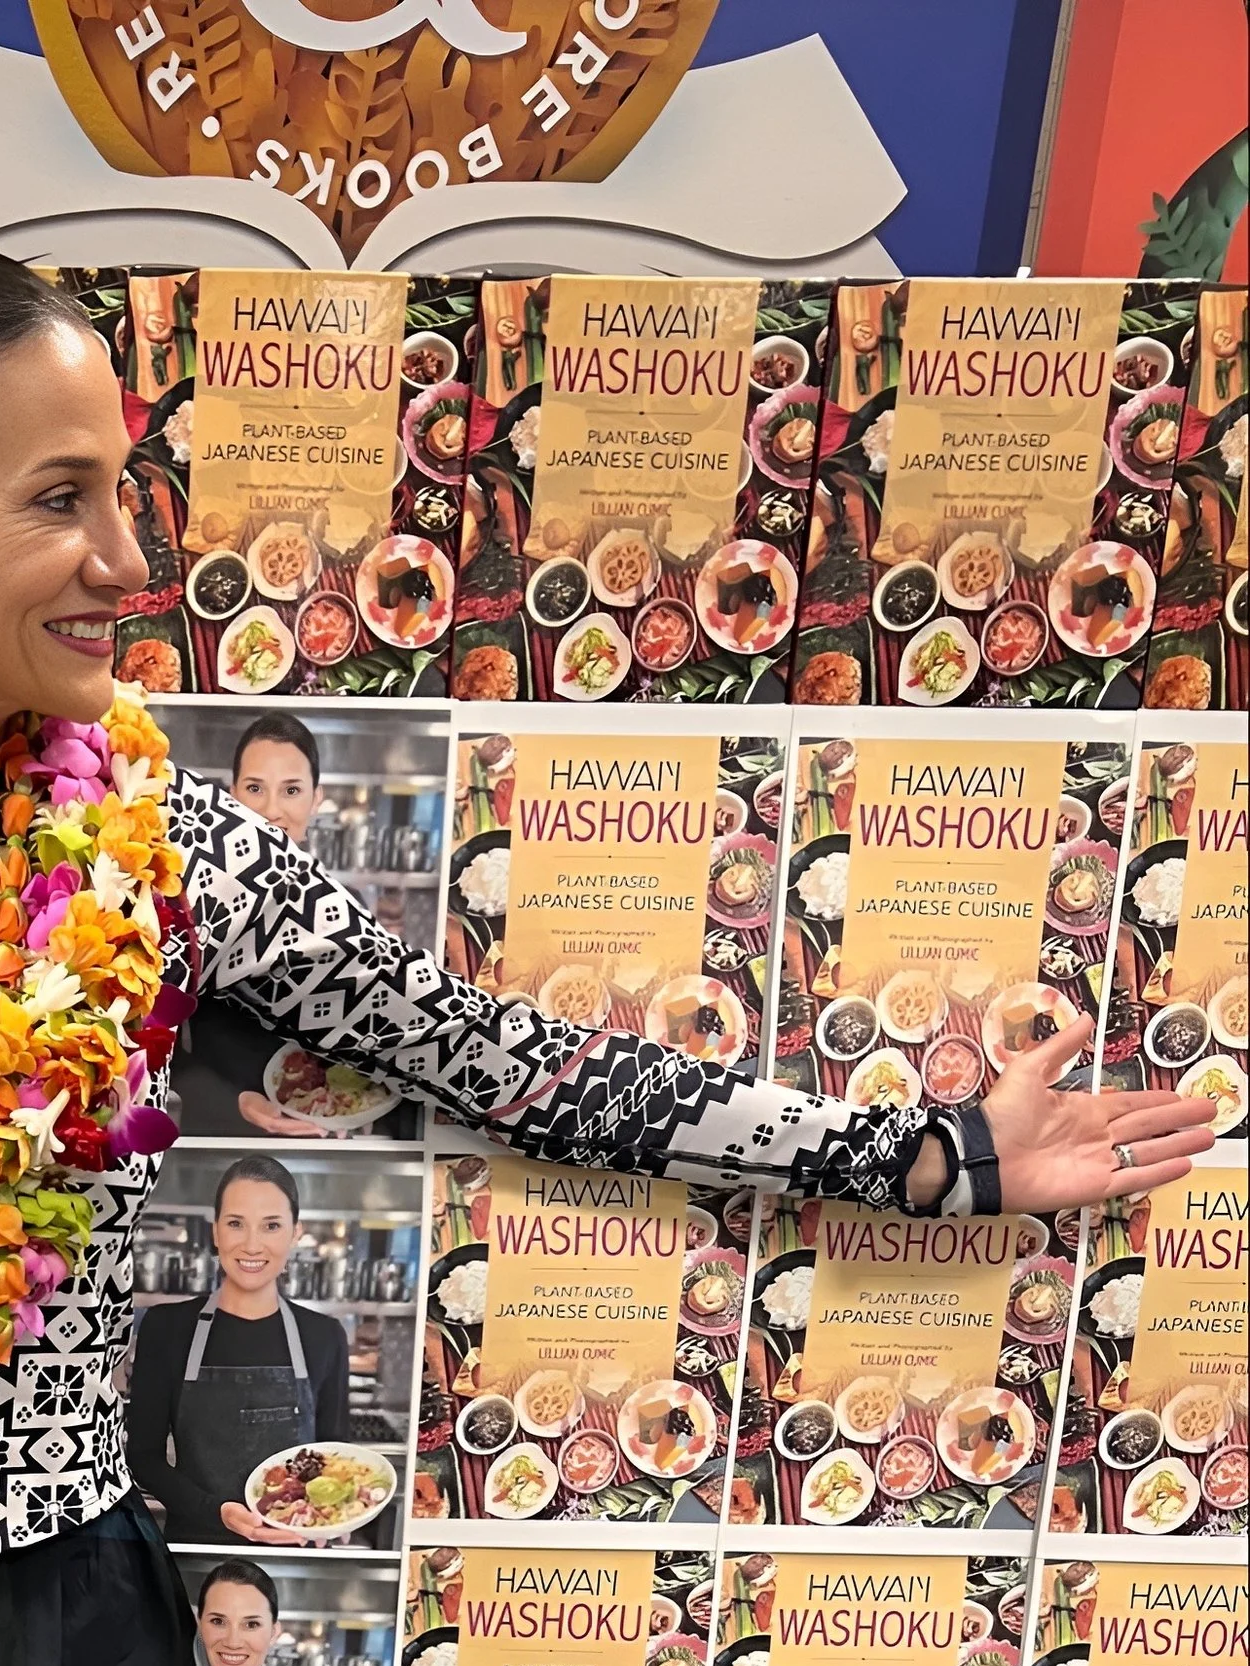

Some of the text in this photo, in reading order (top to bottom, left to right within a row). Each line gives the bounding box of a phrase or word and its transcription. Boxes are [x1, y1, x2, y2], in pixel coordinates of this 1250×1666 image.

[250, 124, 504, 209] BOOKS
[202, 340, 394, 392] WASHOKU
[552, 346, 742, 396] WASHOKU
[908, 350, 1106, 398] WASHOKU
[202, 444, 384, 464] JAPANESE CUISINE
[546, 450, 728, 470] JAPANESE CUISINE
[900, 454, 1088, 472] JAPANESE CUISINE
[520, 800, 706, 844] WASHOKU
[860, 804, 1048, 850] WASHOKU
[518, 894, 694, 912] JAPANESE CUISINE
[856, 898, 1034, 918] JAPANESE CUISINE
[496, 1214, 680, 1258] WASHOKU
[826, 1220, 1010, 1264] WASHOKU
[494, 1302, 668, 1320] JAPANESE CUISINE
[818, 1310, 992, 1328] JAPANESE CUISINE
[1148, 1316, 1246, 1334] JAPANESE
[468, 1600, 642, 1642] WASHOKU
[780, 1608, 954, 1648] WASHOKU
